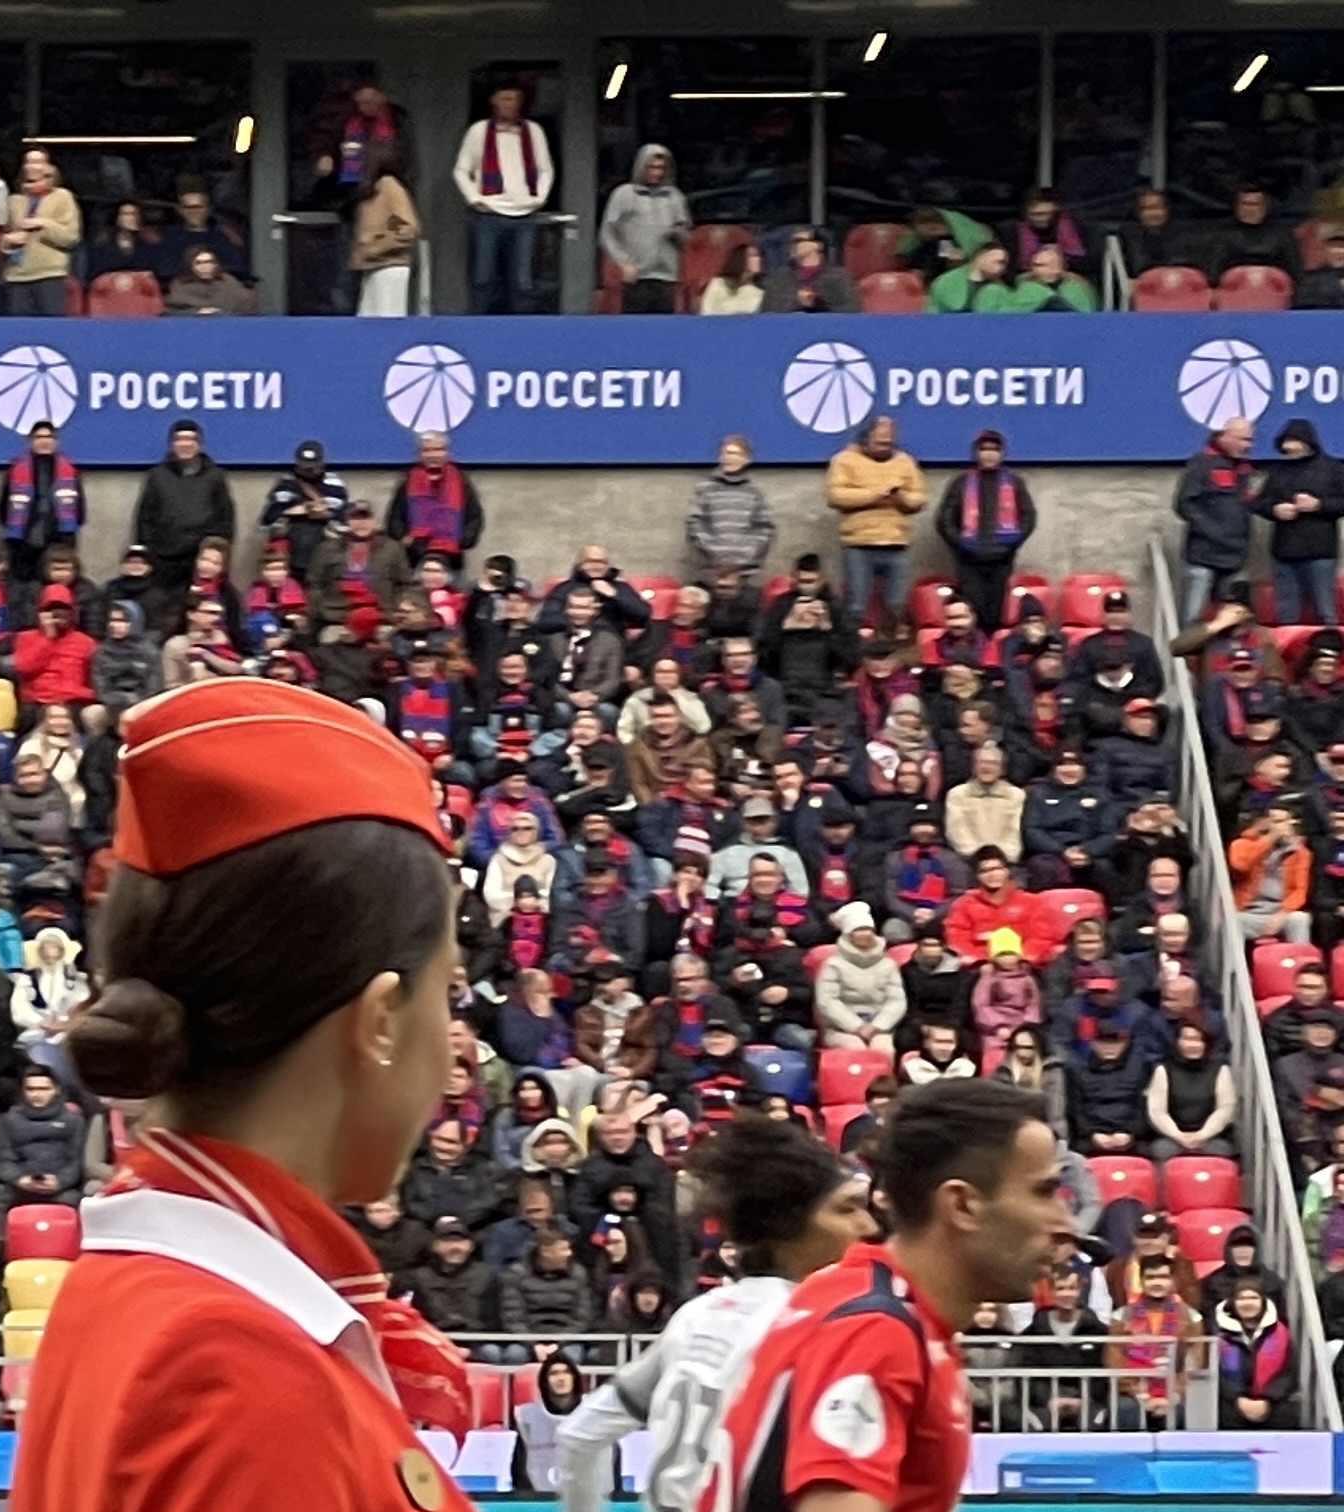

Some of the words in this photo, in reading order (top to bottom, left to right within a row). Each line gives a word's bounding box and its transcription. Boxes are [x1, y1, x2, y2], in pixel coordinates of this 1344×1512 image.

[90, 371, 282, 410] РОССЕТИ
[487, 369, 681, 408] РОССЕТИ
[888, 367, 1083, 406] РОССЕТИ
